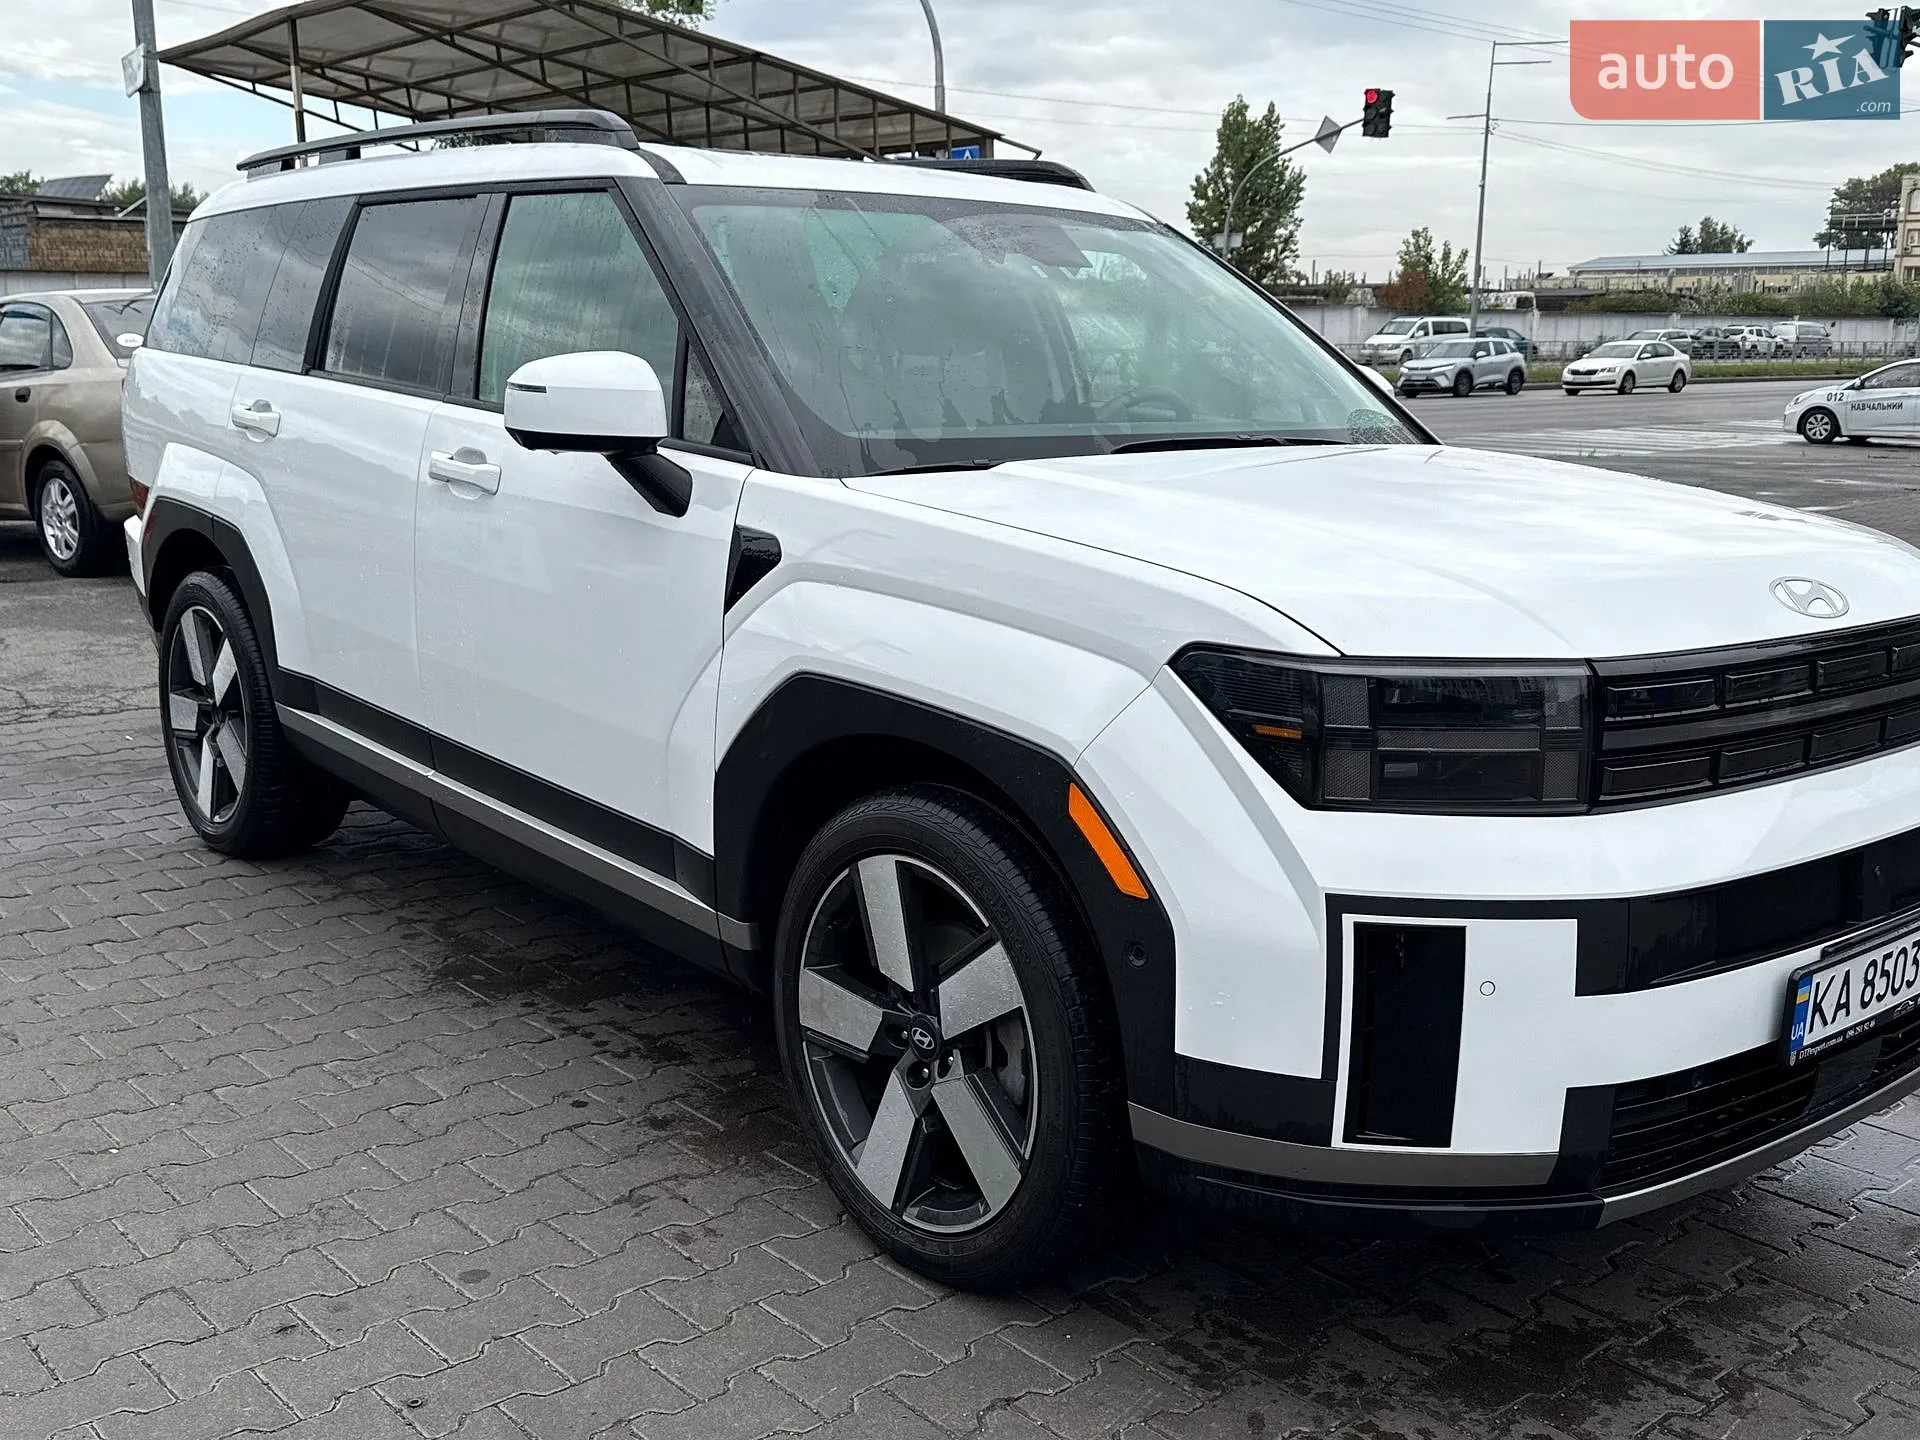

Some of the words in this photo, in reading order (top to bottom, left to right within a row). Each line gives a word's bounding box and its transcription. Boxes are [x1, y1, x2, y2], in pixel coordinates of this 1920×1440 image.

[1826, 392, 1845, 402] 012
[1808, 967, 1851, 1035] KA
[1860, 938, 1920, 1010] 8503
[1791, 1022, 1804, 1041] UA
